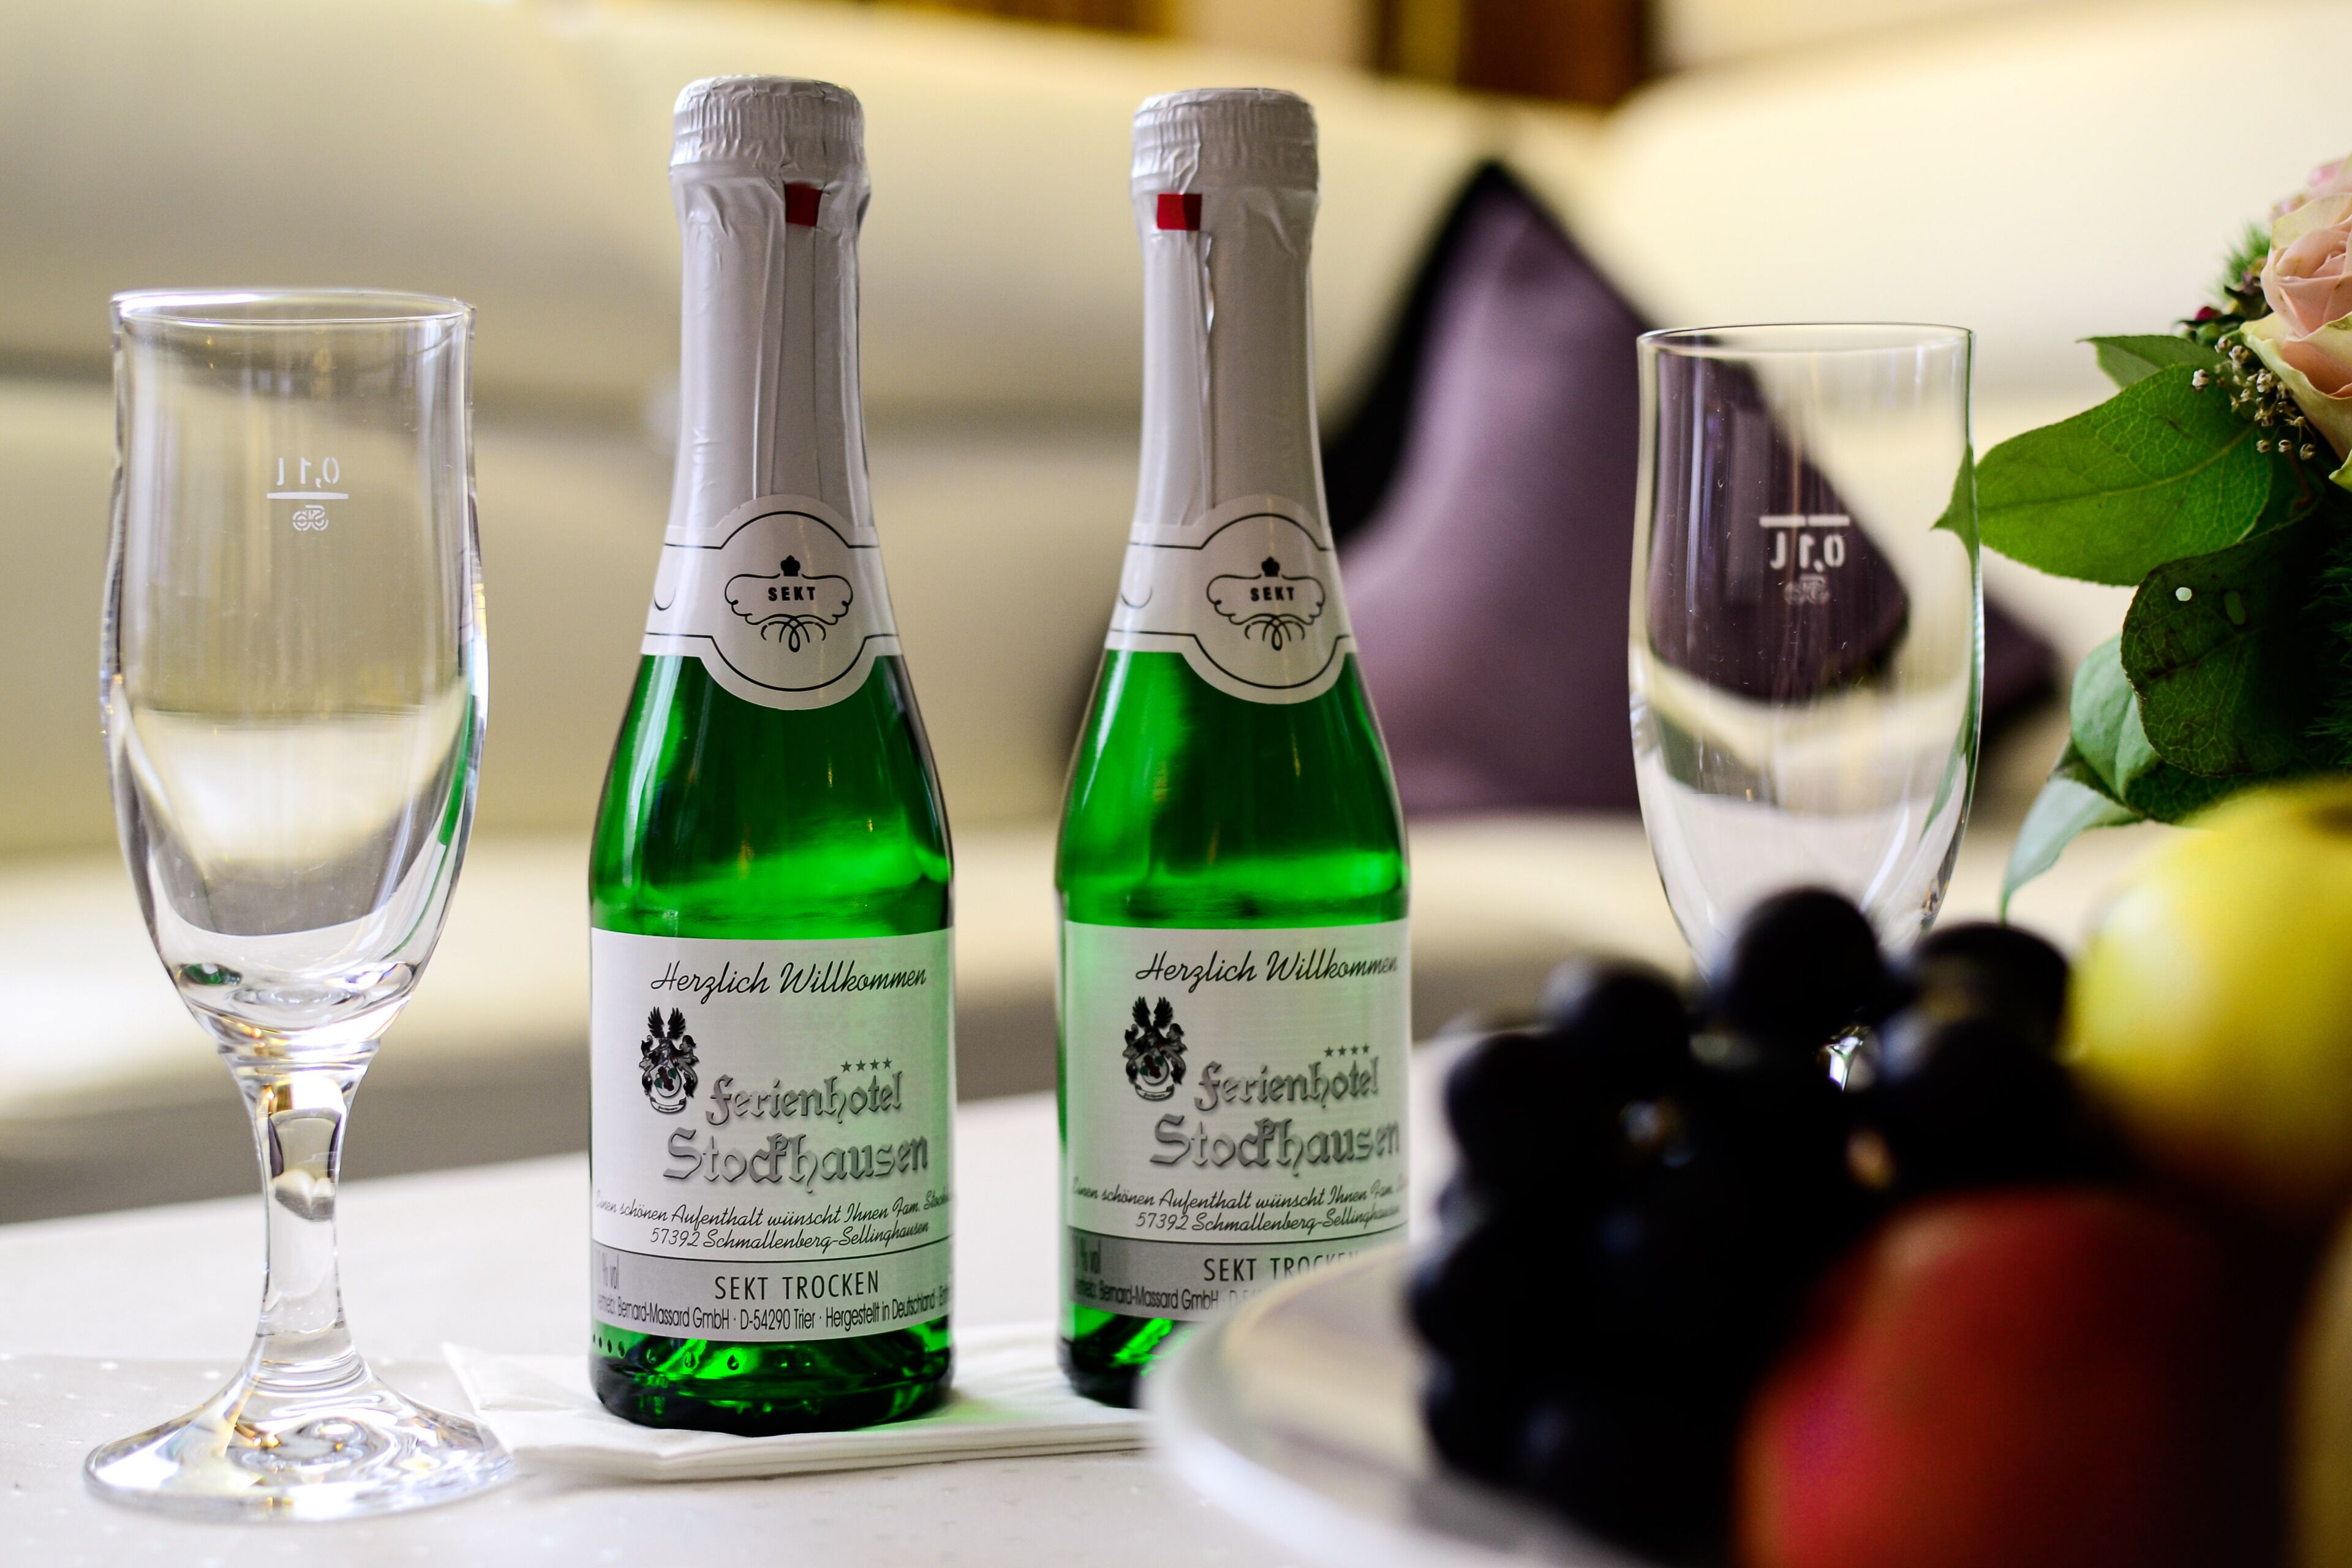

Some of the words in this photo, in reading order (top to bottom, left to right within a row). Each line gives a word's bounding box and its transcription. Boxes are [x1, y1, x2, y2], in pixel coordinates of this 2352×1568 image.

[767, 586, 816, 601] SEKT
[1250, 586, 1294, 601] SEKT
[650, 960, 770, 1005] Herzlich
[780, 960, 927, 993] Willkommen
[1135, 950, 1257, 993] Herzlich
[1266, 948, 1399, 981] Willkommen
[663, 1127, 928, 1193] Stockhausen
[1149, 1112, 1400, 1177] Stockhausen
[620, 1199, 668, 1223] schönen
[671, 1204, 764, 1231] Aufenthalt
[767, 1205, 842, 1226] wünscht
[843, 1202, 889, 1224] Ihnen
[1102, 1184, 1155, 1206] schönen
[1159, 1188, 1253, 1215] Aufenthalt
[1255, 1187, 1325, 1209] wünscht
[1327, 1185, 1368, 1205] Ihnen
[650, 1227, 700, 1248] 57392
[703, 1220, 929, 1254] Schmallenberg-Sellinghausen
[1136, 1212, 1188, 1231] 57392
[715, 1276, 769, 1300] SEKT
[782, 1270, 879, 1300] TROCKEN
[1203, 1258, 1257, 1281] SEKT
[617, 1296, 690, 1328] Bernard-Massard
[692, 1306, 729, 1330] GmbH
[741, 1308, 791, 1330] D-54290
[794, 1308, 816, 1329] Trier
[826, 1302, 880, 1332] Hergestellt
[882, 1301, 890, 1321] in
[892, 1287, 935, 1319] Deutschland
[1181, 1289, 1218, 1310] GmbH
